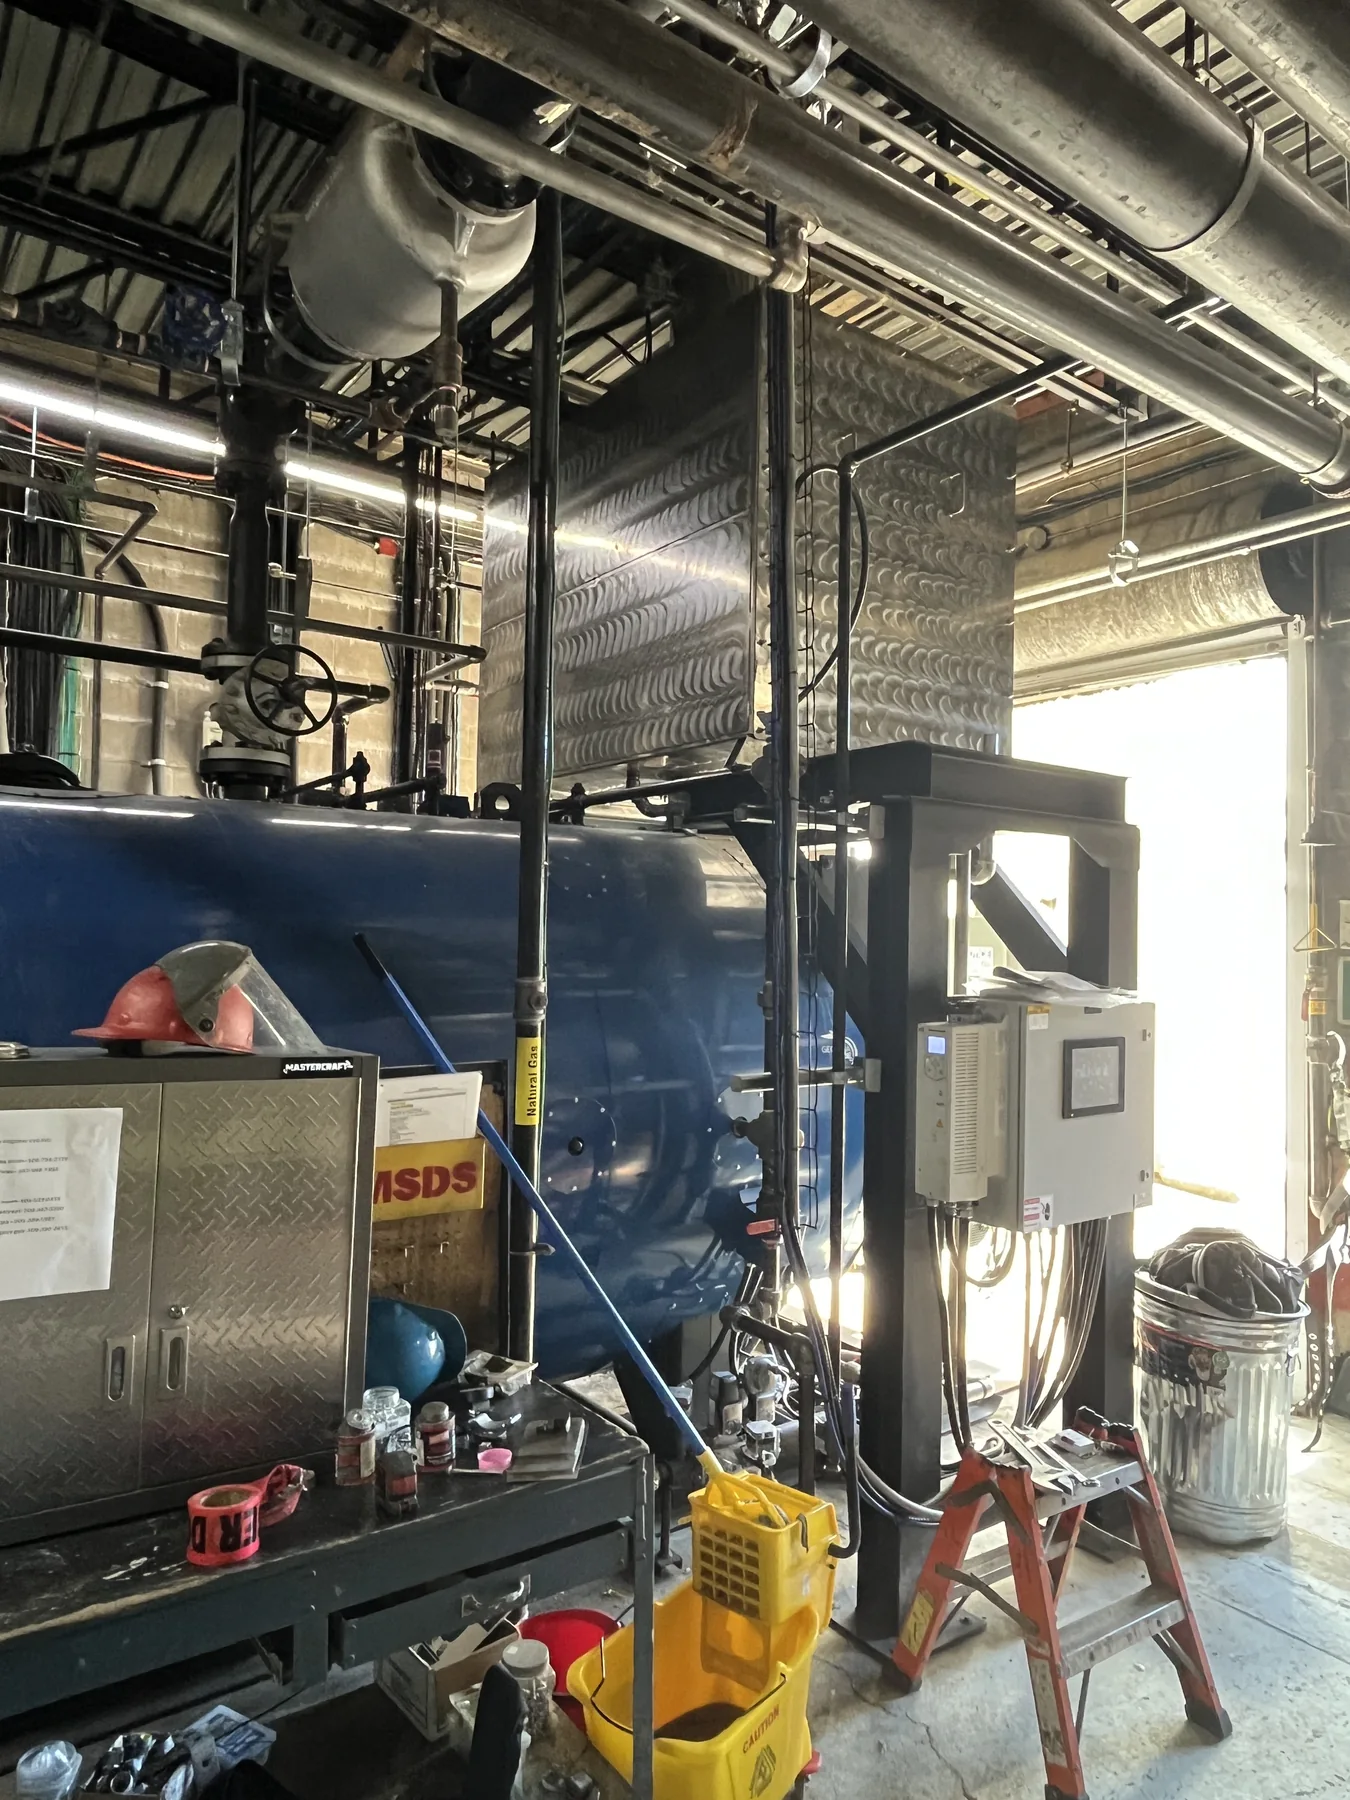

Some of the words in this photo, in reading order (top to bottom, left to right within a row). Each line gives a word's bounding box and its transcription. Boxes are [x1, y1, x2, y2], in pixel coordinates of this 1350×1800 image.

[284, 1061, 352, 1073] MASTERCRAFT
[528, 1045, 538, 1069] Gas
[527, 1073, 538, 1117] Natural
[742, 1703, 780, 1754] CAUTION
